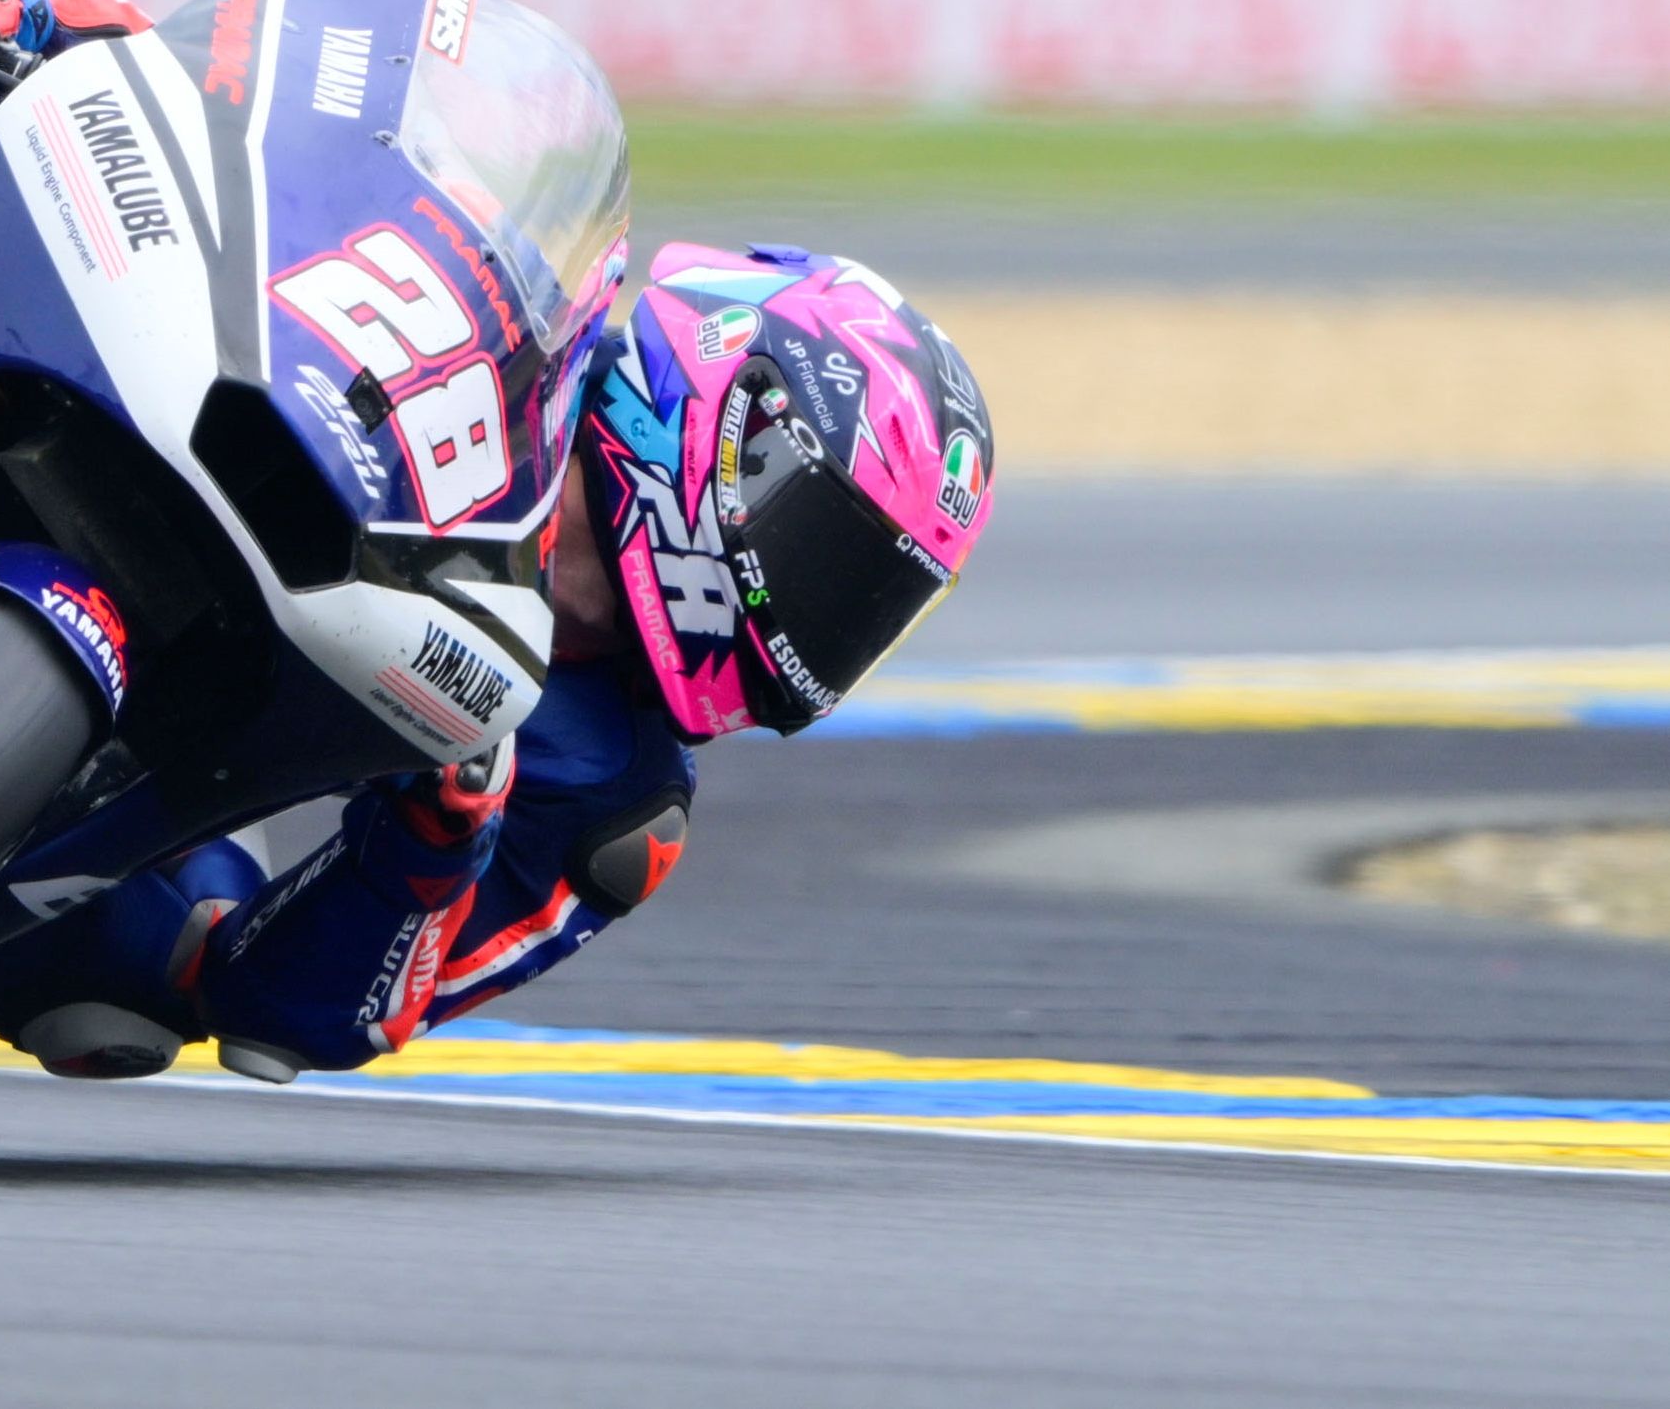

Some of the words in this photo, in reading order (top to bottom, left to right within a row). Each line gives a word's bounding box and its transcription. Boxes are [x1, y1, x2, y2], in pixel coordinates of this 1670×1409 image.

[312, 25, 373, 119] YAMAHA
[25, 125, 47, 167] Liquid
[40, 162, 63, 204] Engine
[59, 202, 97, 274] Component
[68, 88, 179, 253] YAMALUBE
[412, 197, 522, 354] PRAMAC
[266, 221, 513, 537] 28
[783, 338, 808, 359] JP
[795, 353, 839, 434] Financial
[774, 418, 819, 475] OAKLEY
[41, 587, 124, 712] YAMAHA
[627, 548, 679, 670] PRAMAC
[410, 619, 514, 725] YAMALUBE
